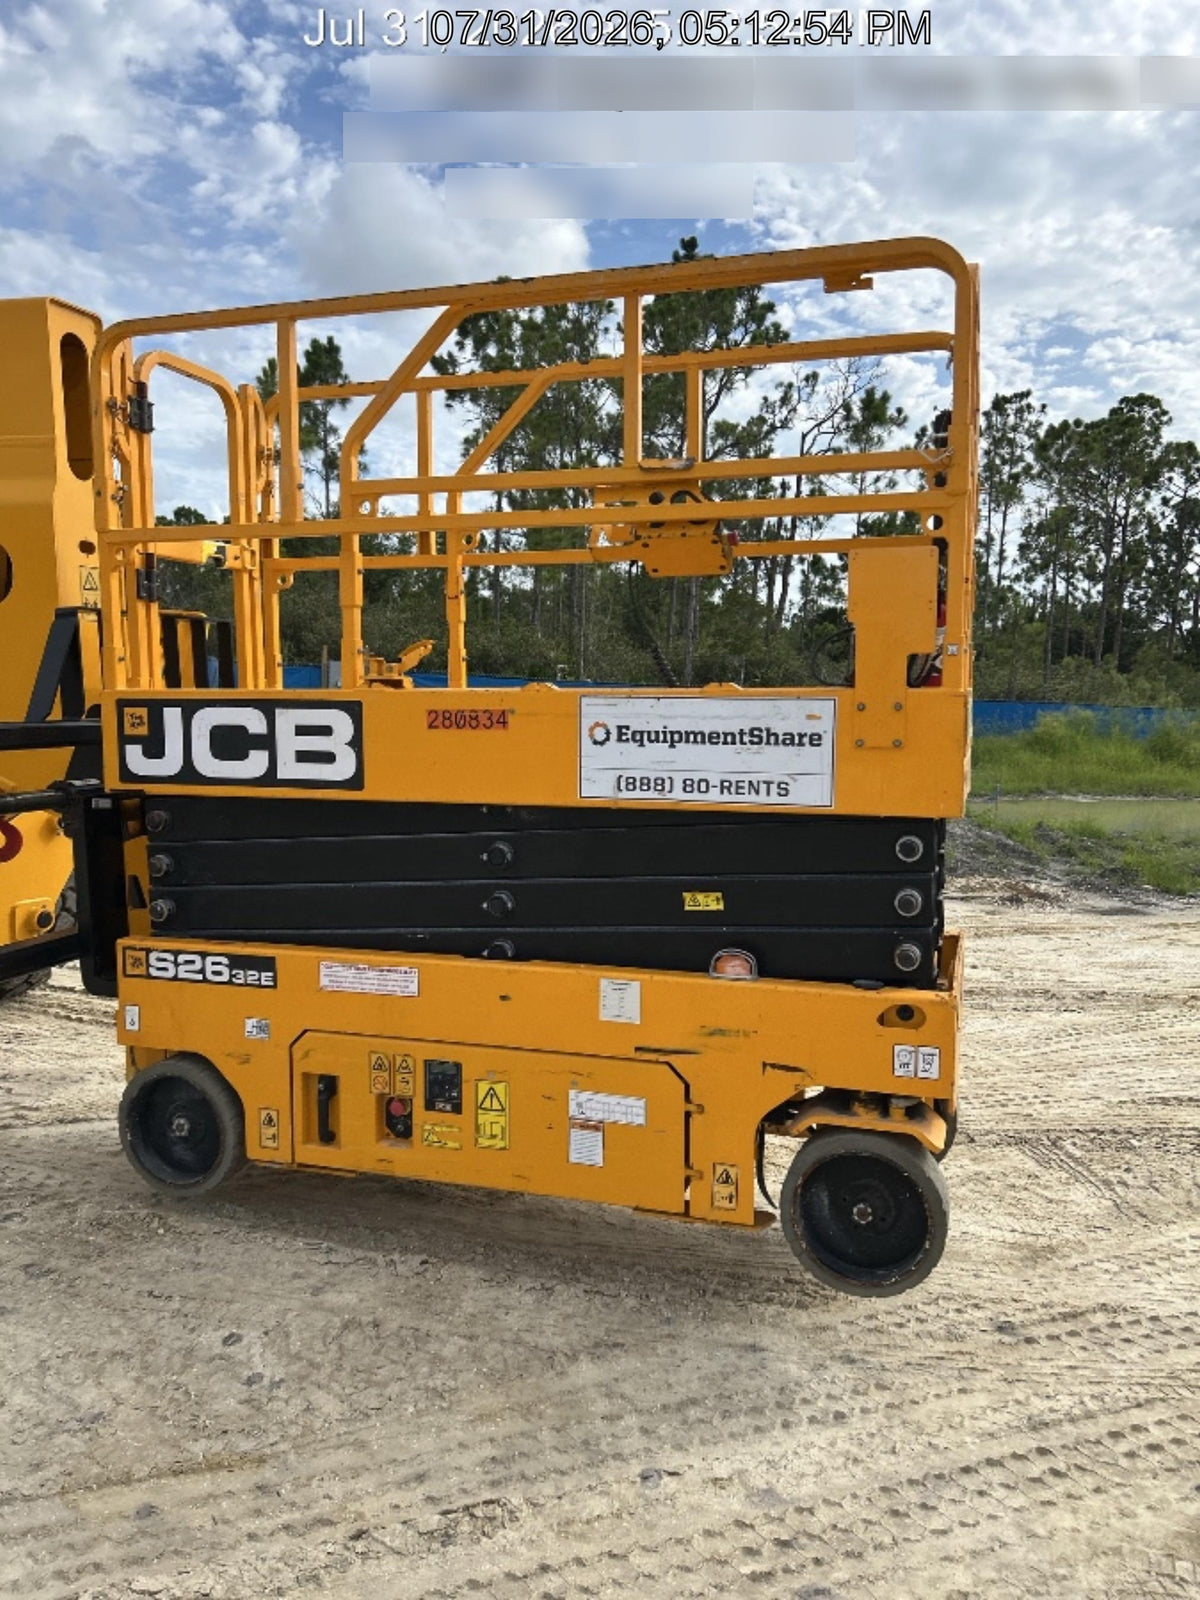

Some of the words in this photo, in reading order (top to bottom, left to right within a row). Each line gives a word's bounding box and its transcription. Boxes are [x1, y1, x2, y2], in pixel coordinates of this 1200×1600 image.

[427, 709, 509, 730] 280834
[125, 706, 358, 781] JCB
[616, 725, 823, 749] EquipmentShare
[616, 774, 674, 794] (888)
[682, 777, 790, 797] 80-RENTS
